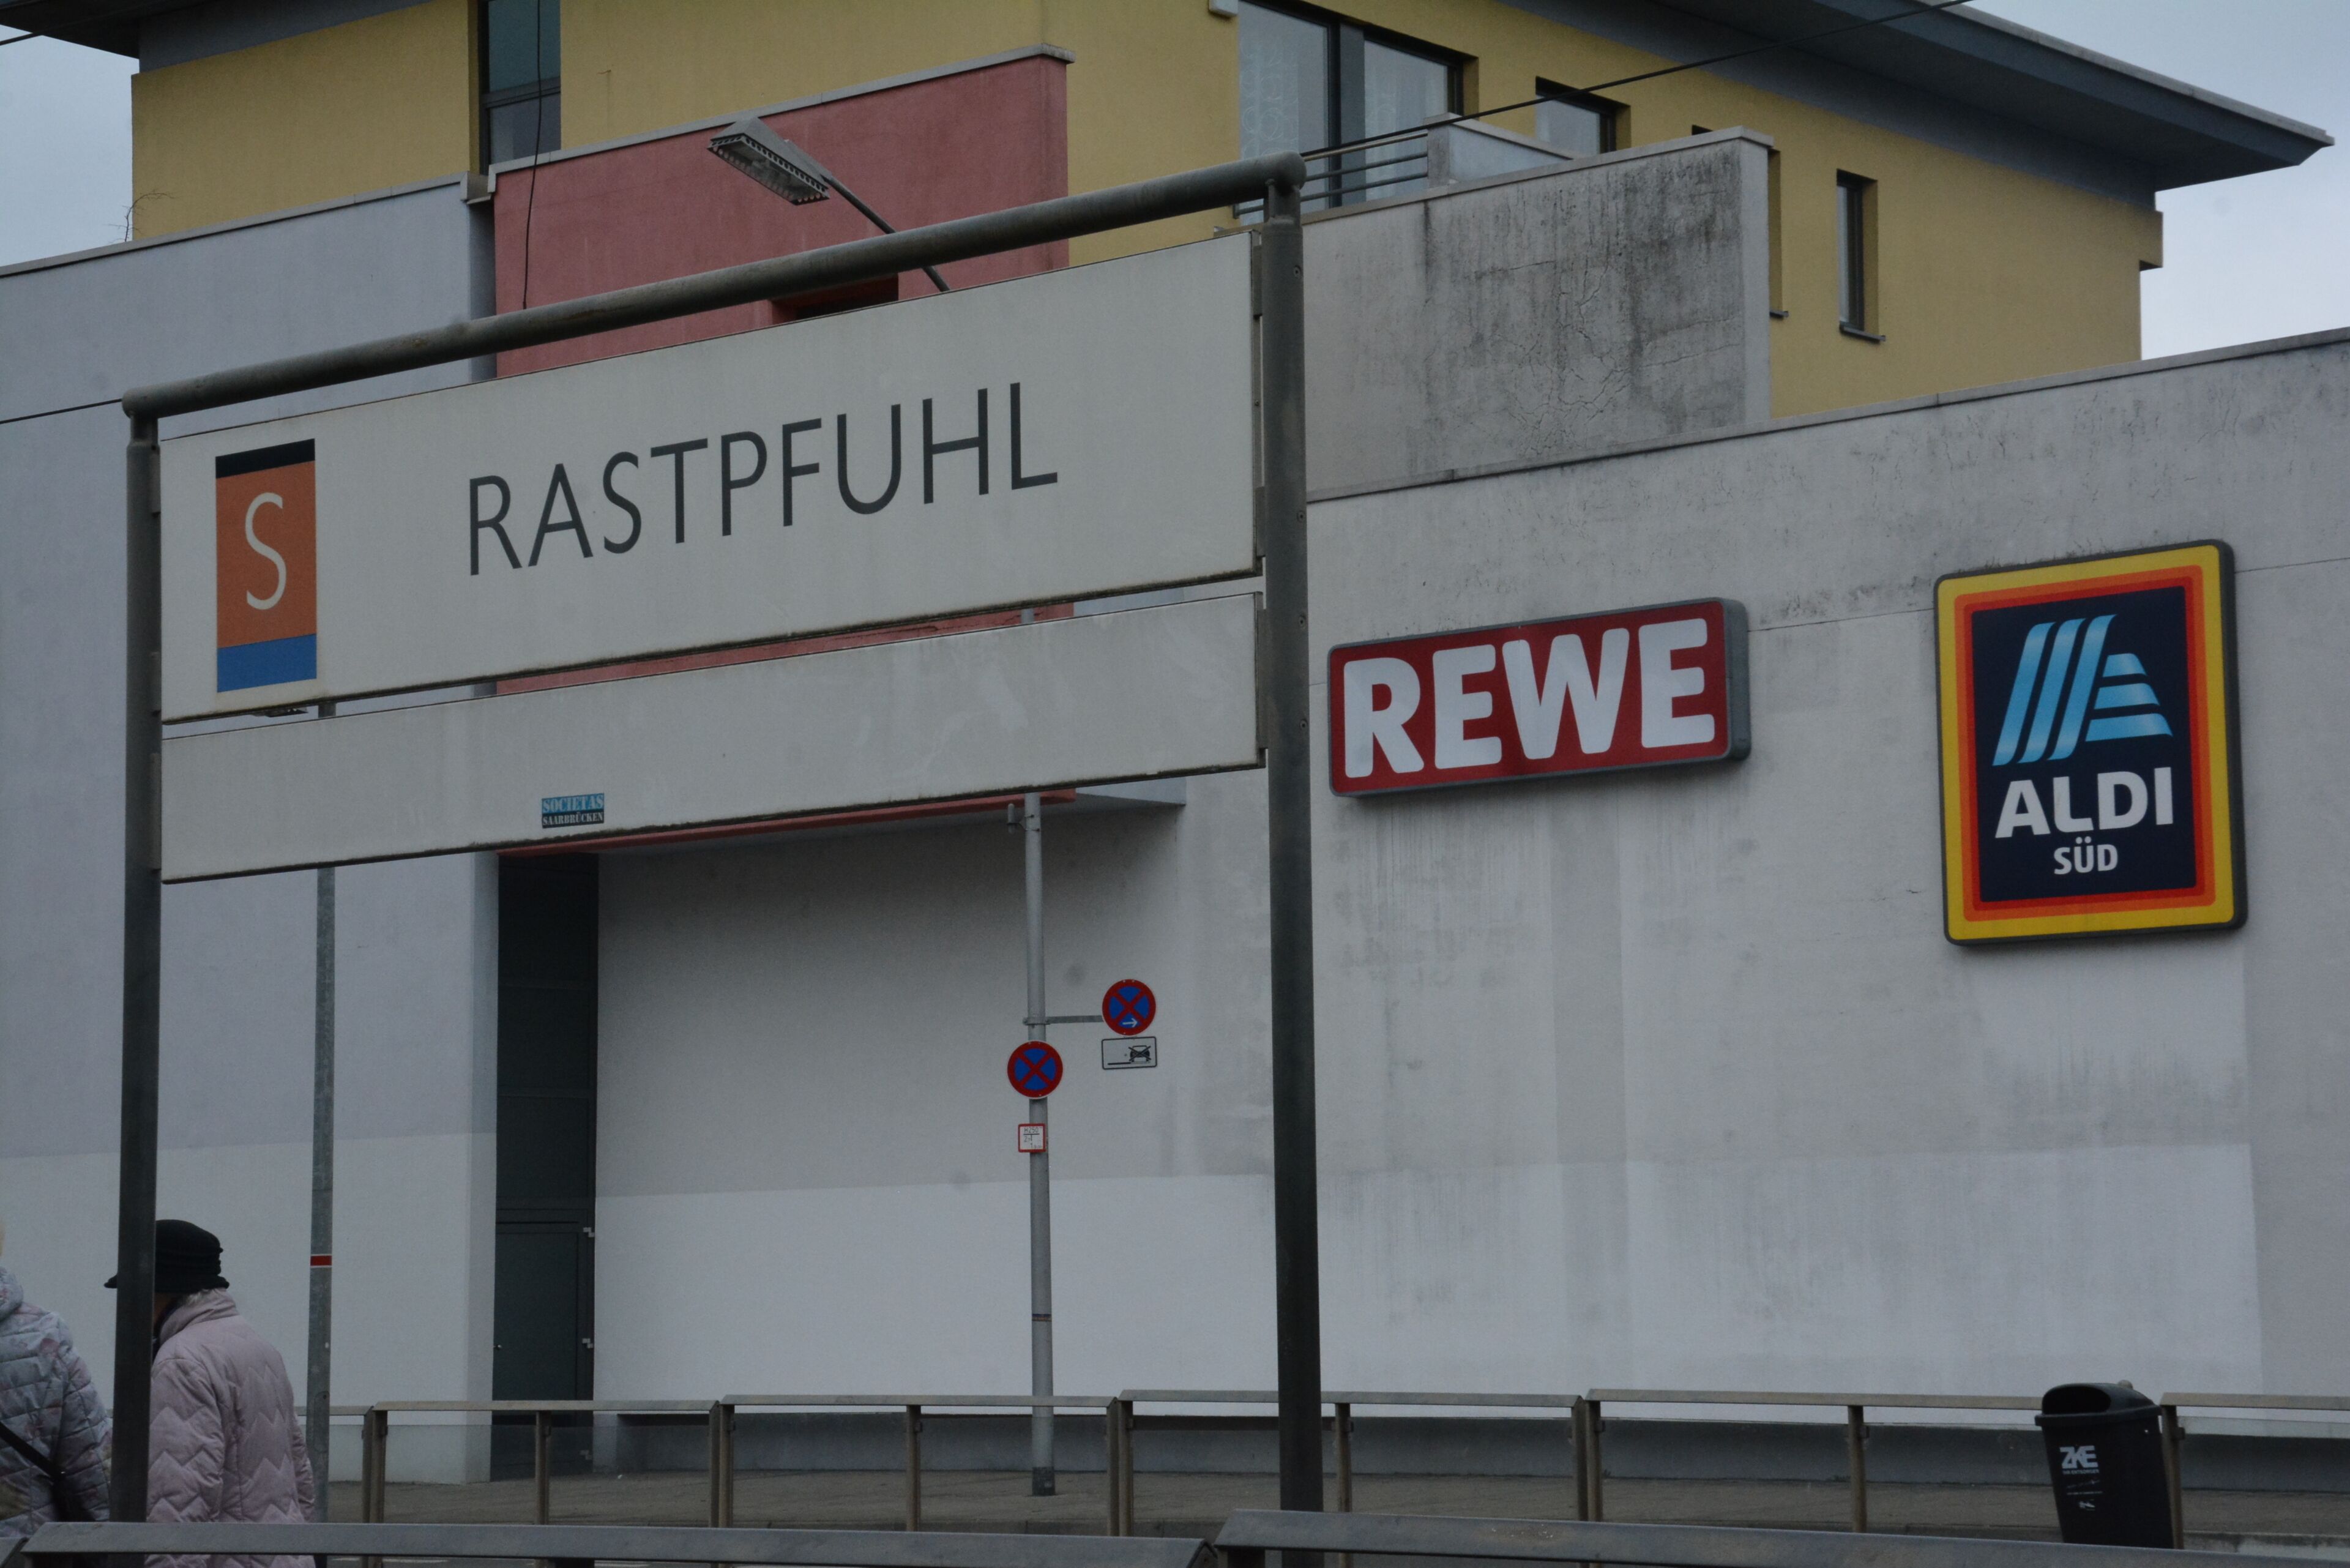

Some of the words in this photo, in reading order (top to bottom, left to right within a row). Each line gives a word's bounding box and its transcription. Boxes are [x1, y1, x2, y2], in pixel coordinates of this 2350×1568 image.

[469, 382, 1059, 576] RASTPFUHL
[244, 491, 288, 610] S
[1344, 618, 1715, 778] REWE
[543, 794, 603, 812] SOCIETAS
[543, 812, 603, 826] SAARBRÜCKEN
[1994, 766, 2174, 838] ALDI
[2054, 836, 2118, 875] SÜD
[2059, 1445, 2098, 1469] ZKE
